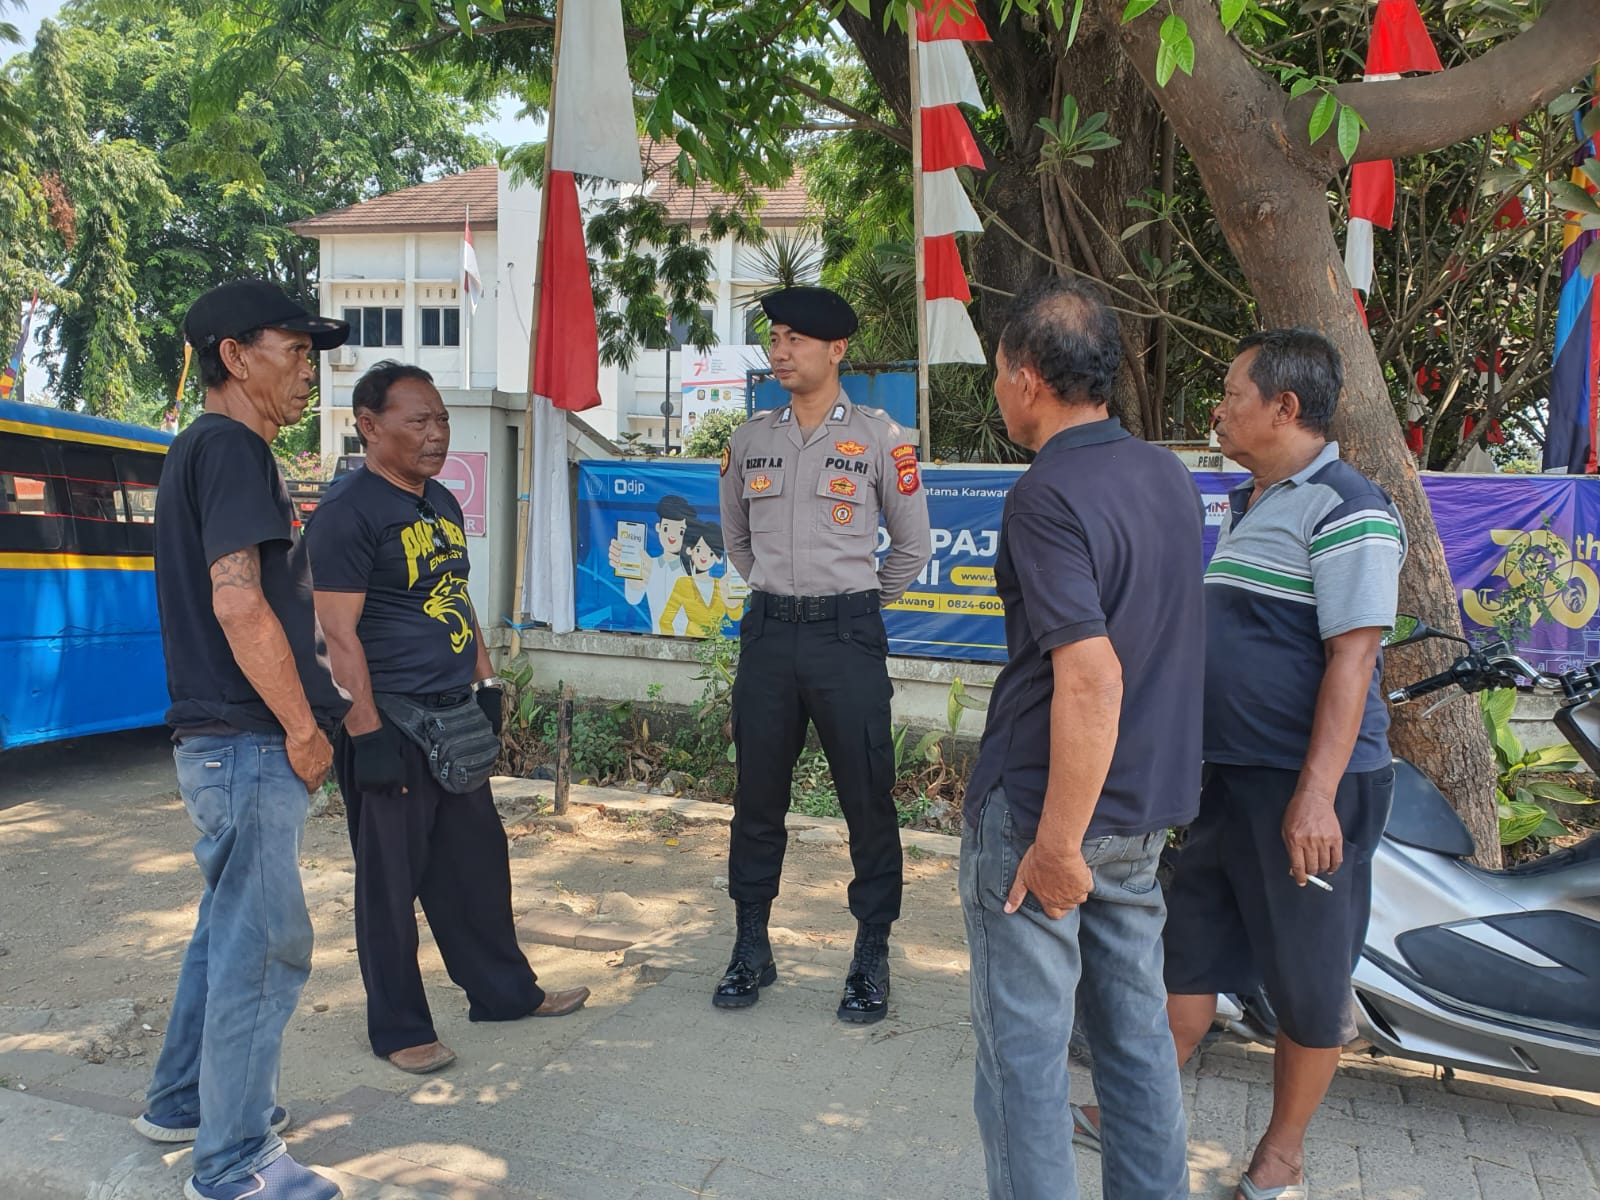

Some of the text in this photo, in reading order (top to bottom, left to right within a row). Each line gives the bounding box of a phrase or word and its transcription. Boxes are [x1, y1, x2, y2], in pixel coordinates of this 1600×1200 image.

[746, 458, 767, 469] RIZKY
[825, 457, 868, 474] POLRI
[930, 528, 998, 557] PAJ
